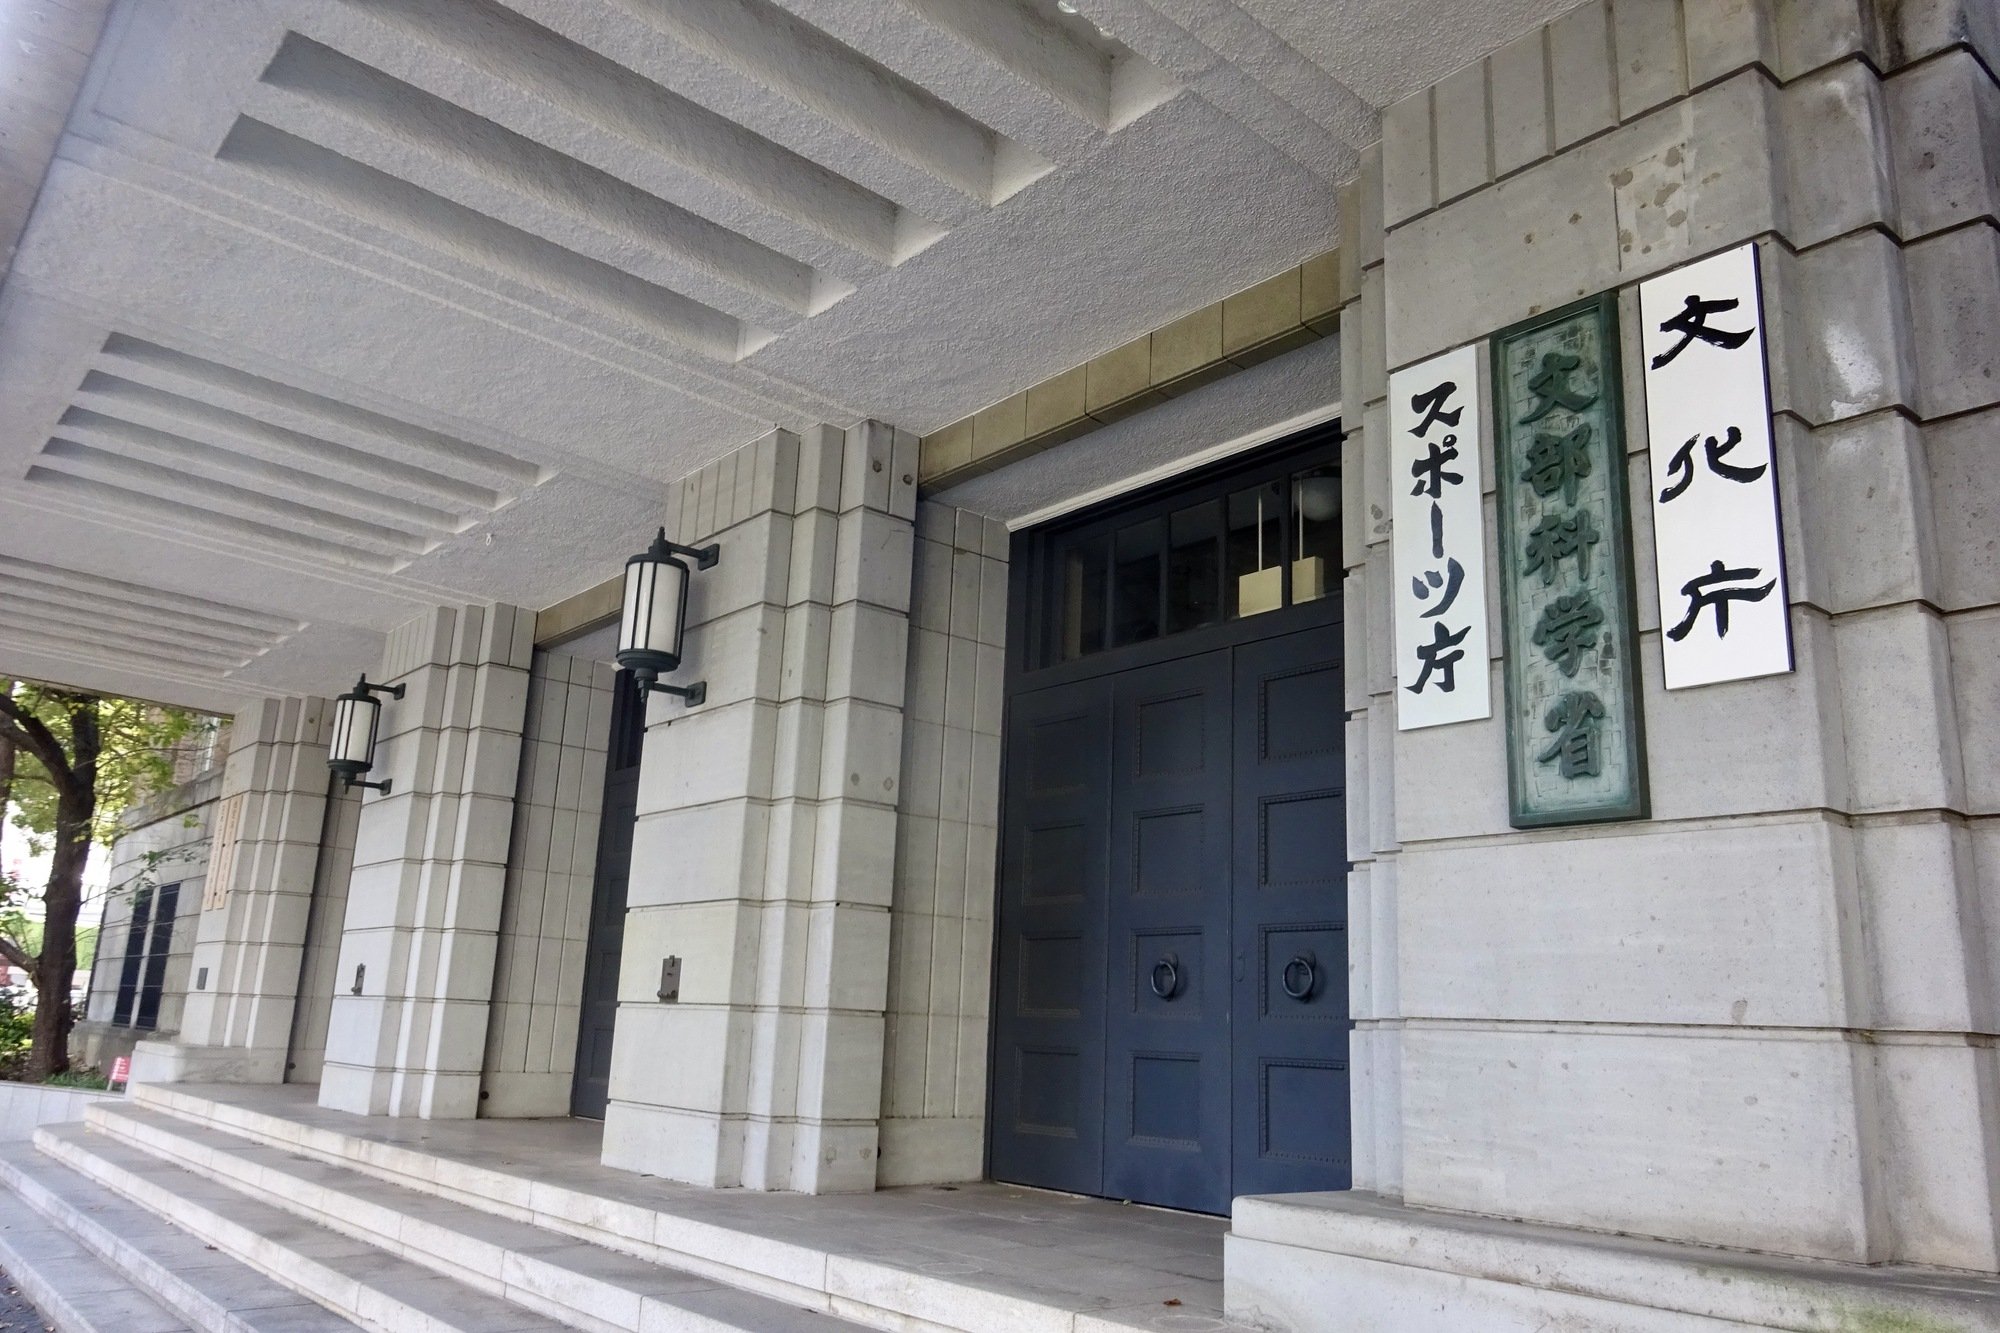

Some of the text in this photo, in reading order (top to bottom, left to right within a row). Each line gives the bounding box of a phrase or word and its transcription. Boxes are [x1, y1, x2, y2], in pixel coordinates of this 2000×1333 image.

[1405, 380, 1472, 695] スポーツ庁
[1518, 351, 1606, 781] 文部科学省
[1651, 294, 1778, 643] 文化庁
